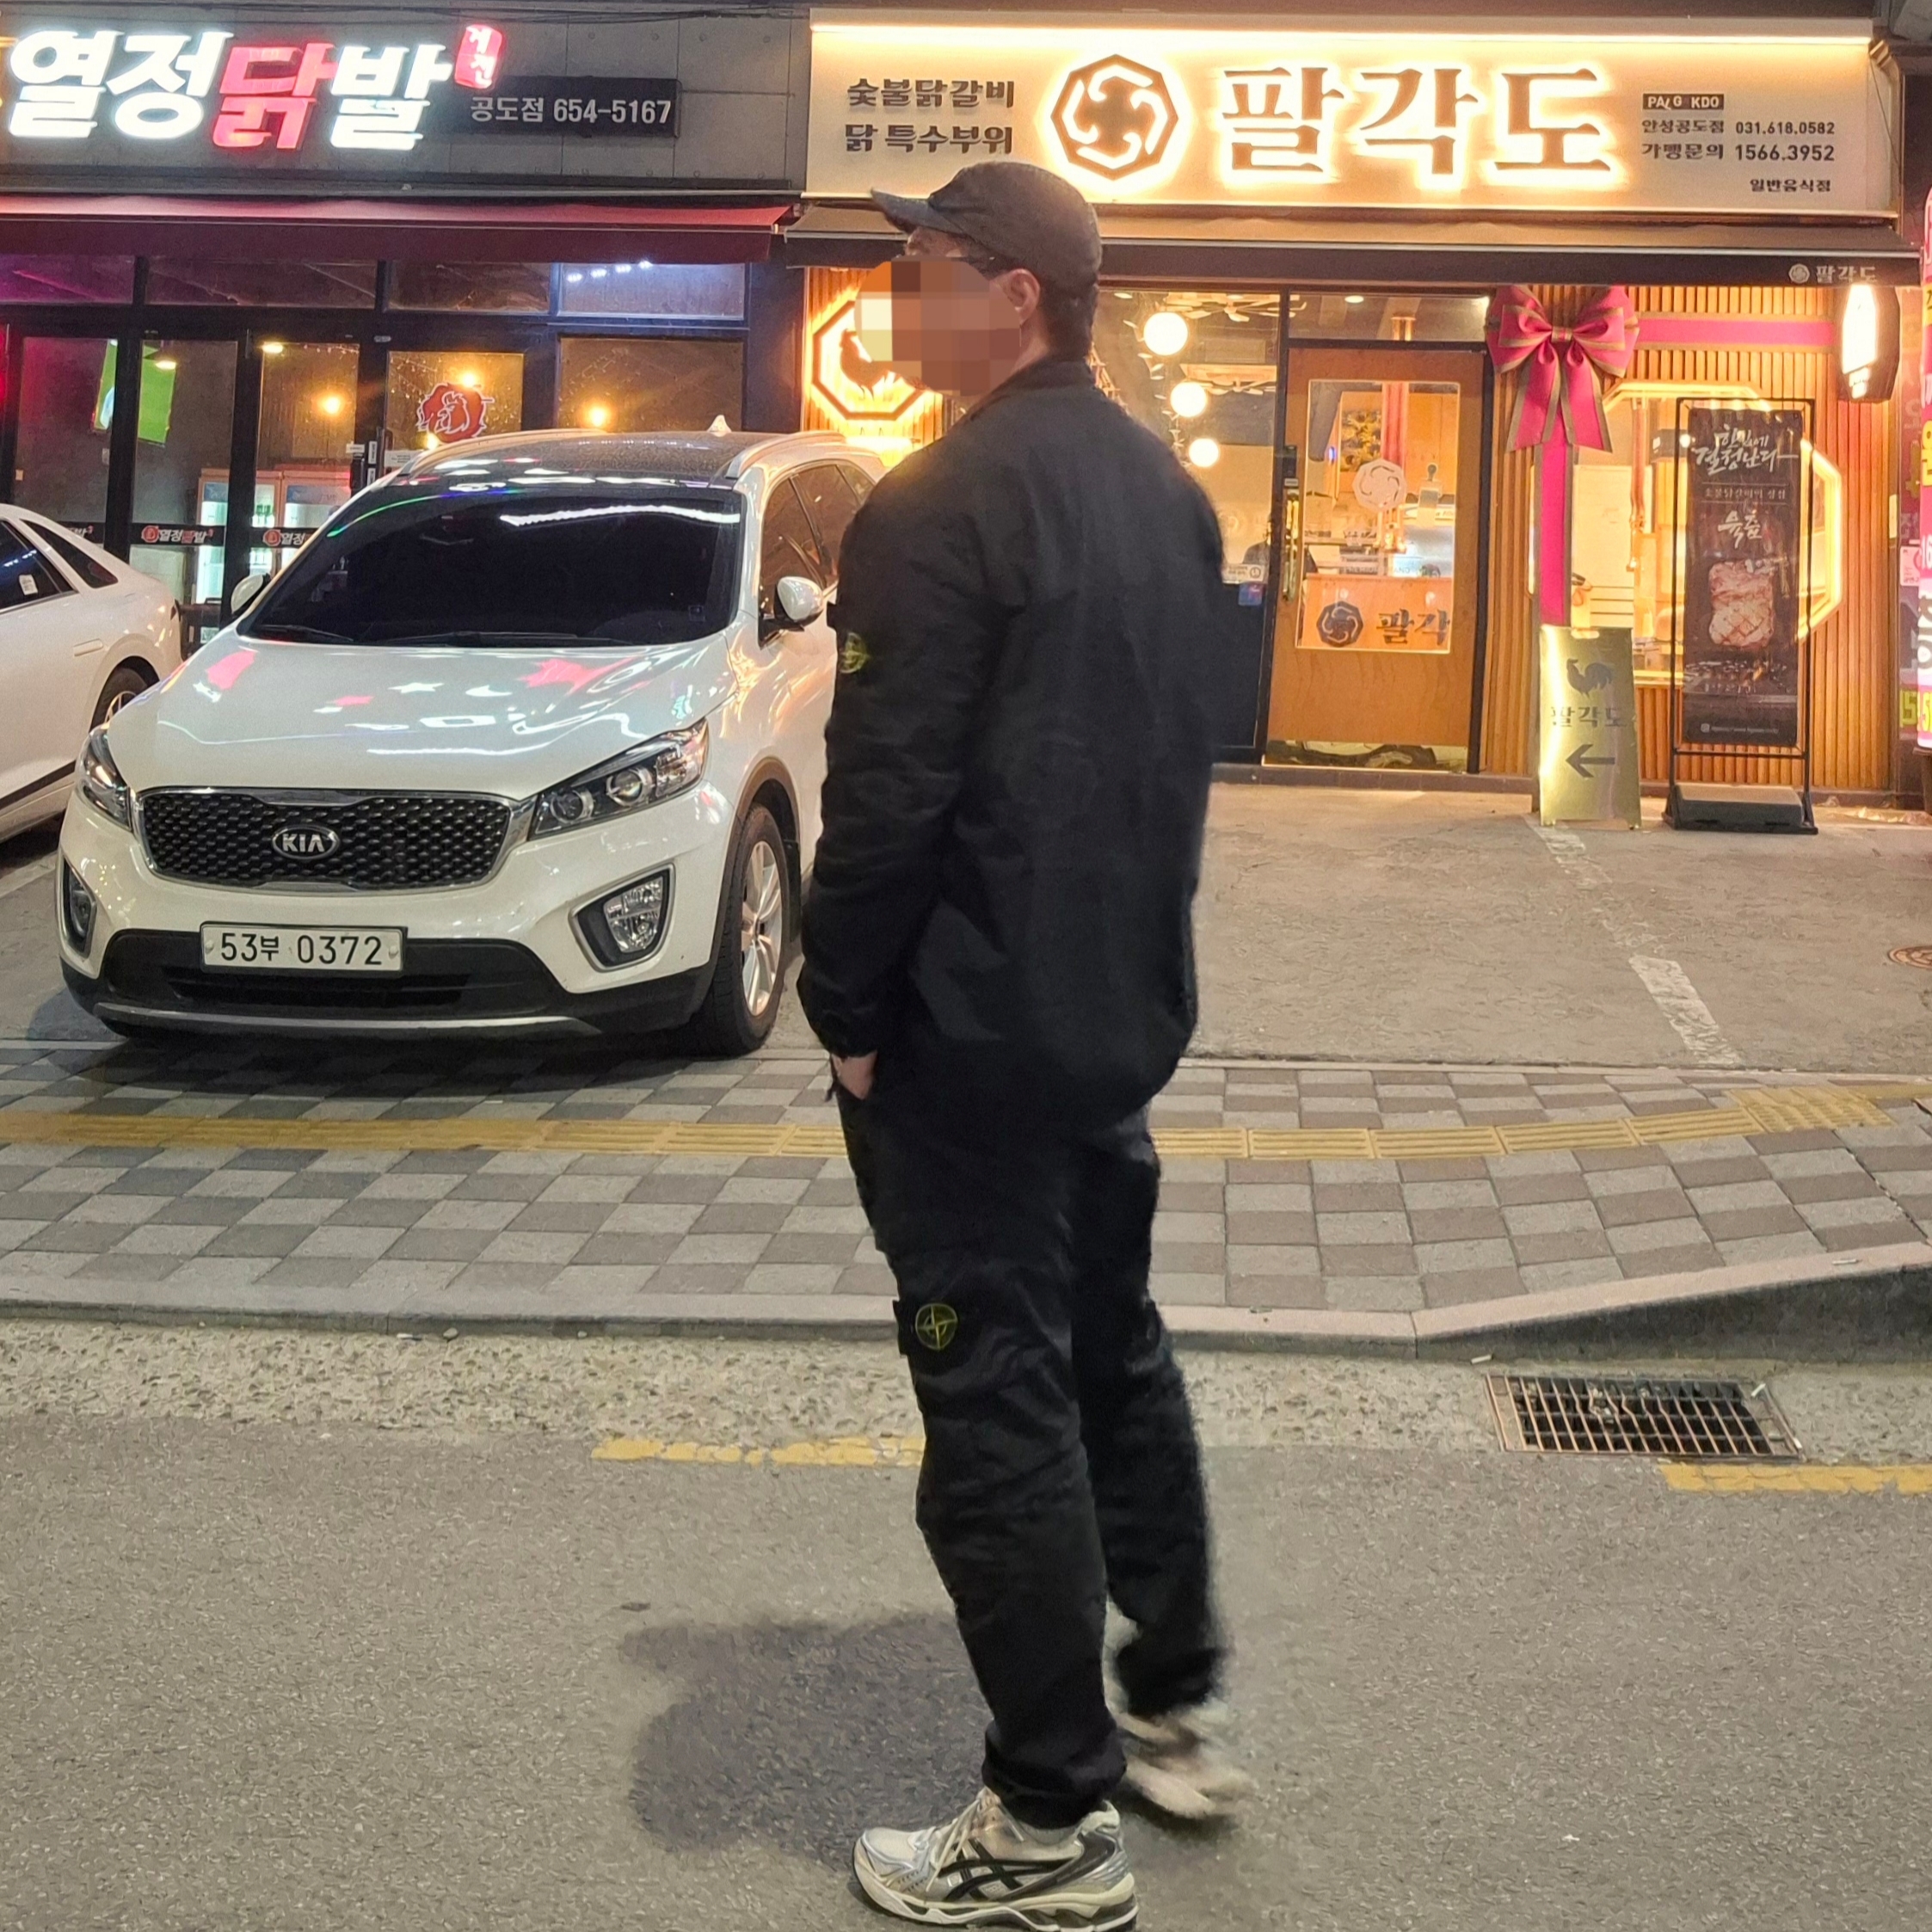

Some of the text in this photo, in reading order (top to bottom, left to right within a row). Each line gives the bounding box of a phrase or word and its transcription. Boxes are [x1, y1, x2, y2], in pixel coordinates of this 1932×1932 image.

[9, 29, 453, 151] 열정닭발
[846, 78, 1015, 108] 숯불닭갈비
[471, 96, 672, 124] 공도점 654-5167
[1221, 66, 1611, 175] 팔각도
[845, 124, 1013, 155] 닭 특수부위
[1641, 119, 1836, 135] 안성공도점 031.618.0582
[1641, 143, 1836, 162] 가맹문의 1566.3952
[1750, 178, 1831, 193] 일반음식점
[1816, 265, 1877, 284] 팔각도
[282, 833, 325, 853] KIA
[220, 932, 383, 965] 53부 0372
